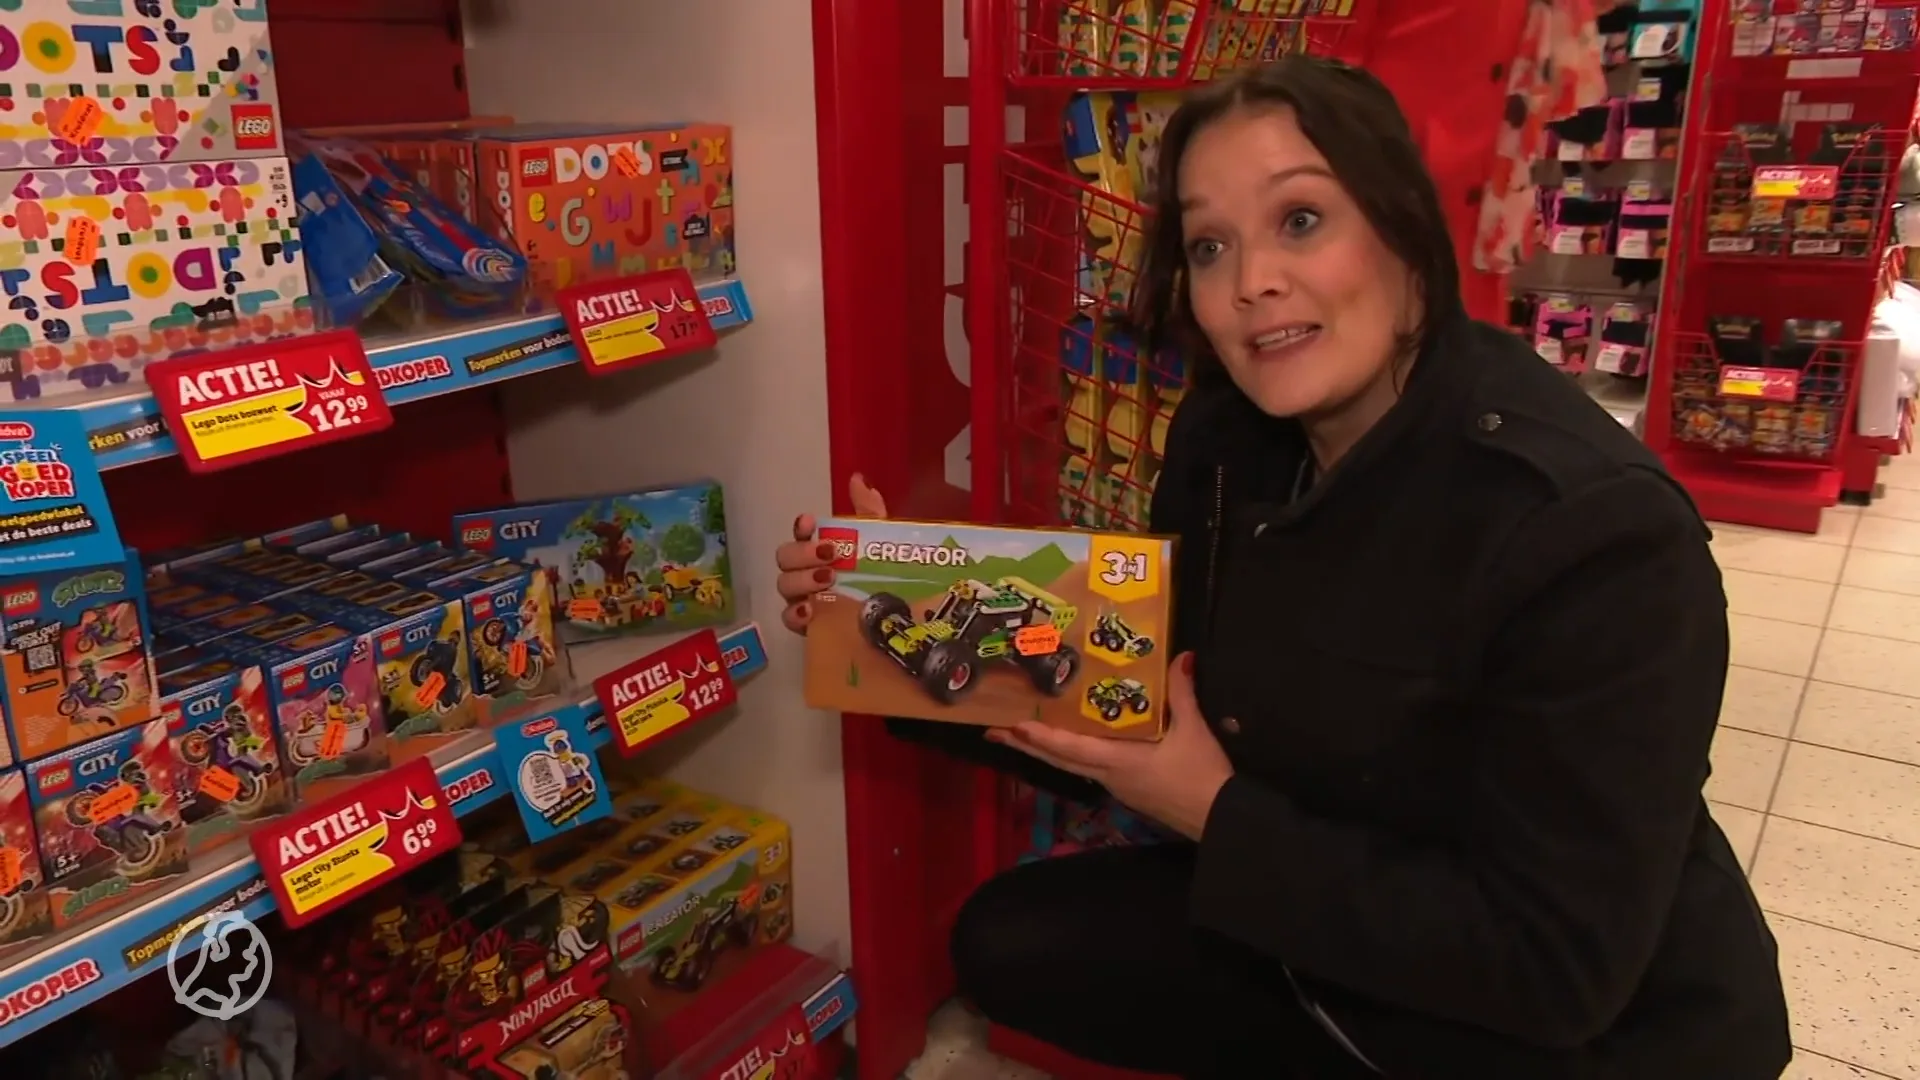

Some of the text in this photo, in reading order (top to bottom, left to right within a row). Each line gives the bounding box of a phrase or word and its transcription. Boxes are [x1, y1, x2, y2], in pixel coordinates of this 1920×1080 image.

[236, 118, 272, 137] LEGO
[523, 158, 549, 177] LEGO
[577, 289, 644, 322] ACTIE!
[179, 359, 284, 406] ACTIE!
[318, 387, 345, 400] VANAF
[191, 418, 216, 430] Lego
[216, 413, 239, 425] Dots
[309, 395, 368, 433] 12.99
[88, 420, 160, 451] rken voor
[7, 480, 72, 499] KOPER
[11, 529, 26, 540] de
[27, 525, 60, 537] beste
[61, 519, 93, 531] deals
[463, 526, 491, 542] LEGO
[866, 542, 968, 567] CREATOR
[495, 590, 519, 608] CITY
[405, 624, 432, 643] CITY
[310, 658, 339, 680] CITY
[611, 661, 673, 707] ACTIE!
[689, 677, 724, 711] 12.99
[188, 693, 222, 716] CITY
[40, 750, 119, 789] LEGO CITY
[279, 801, 370, 866] ACTIE!
[402, 818, 437, 854] 6.99
[290, 872, 313, 886] Lego
[313, 862, 331, 875] City
[648, 895, 700, 935] CREATOR
[498, 976, 580, 1046] NINJAGO
